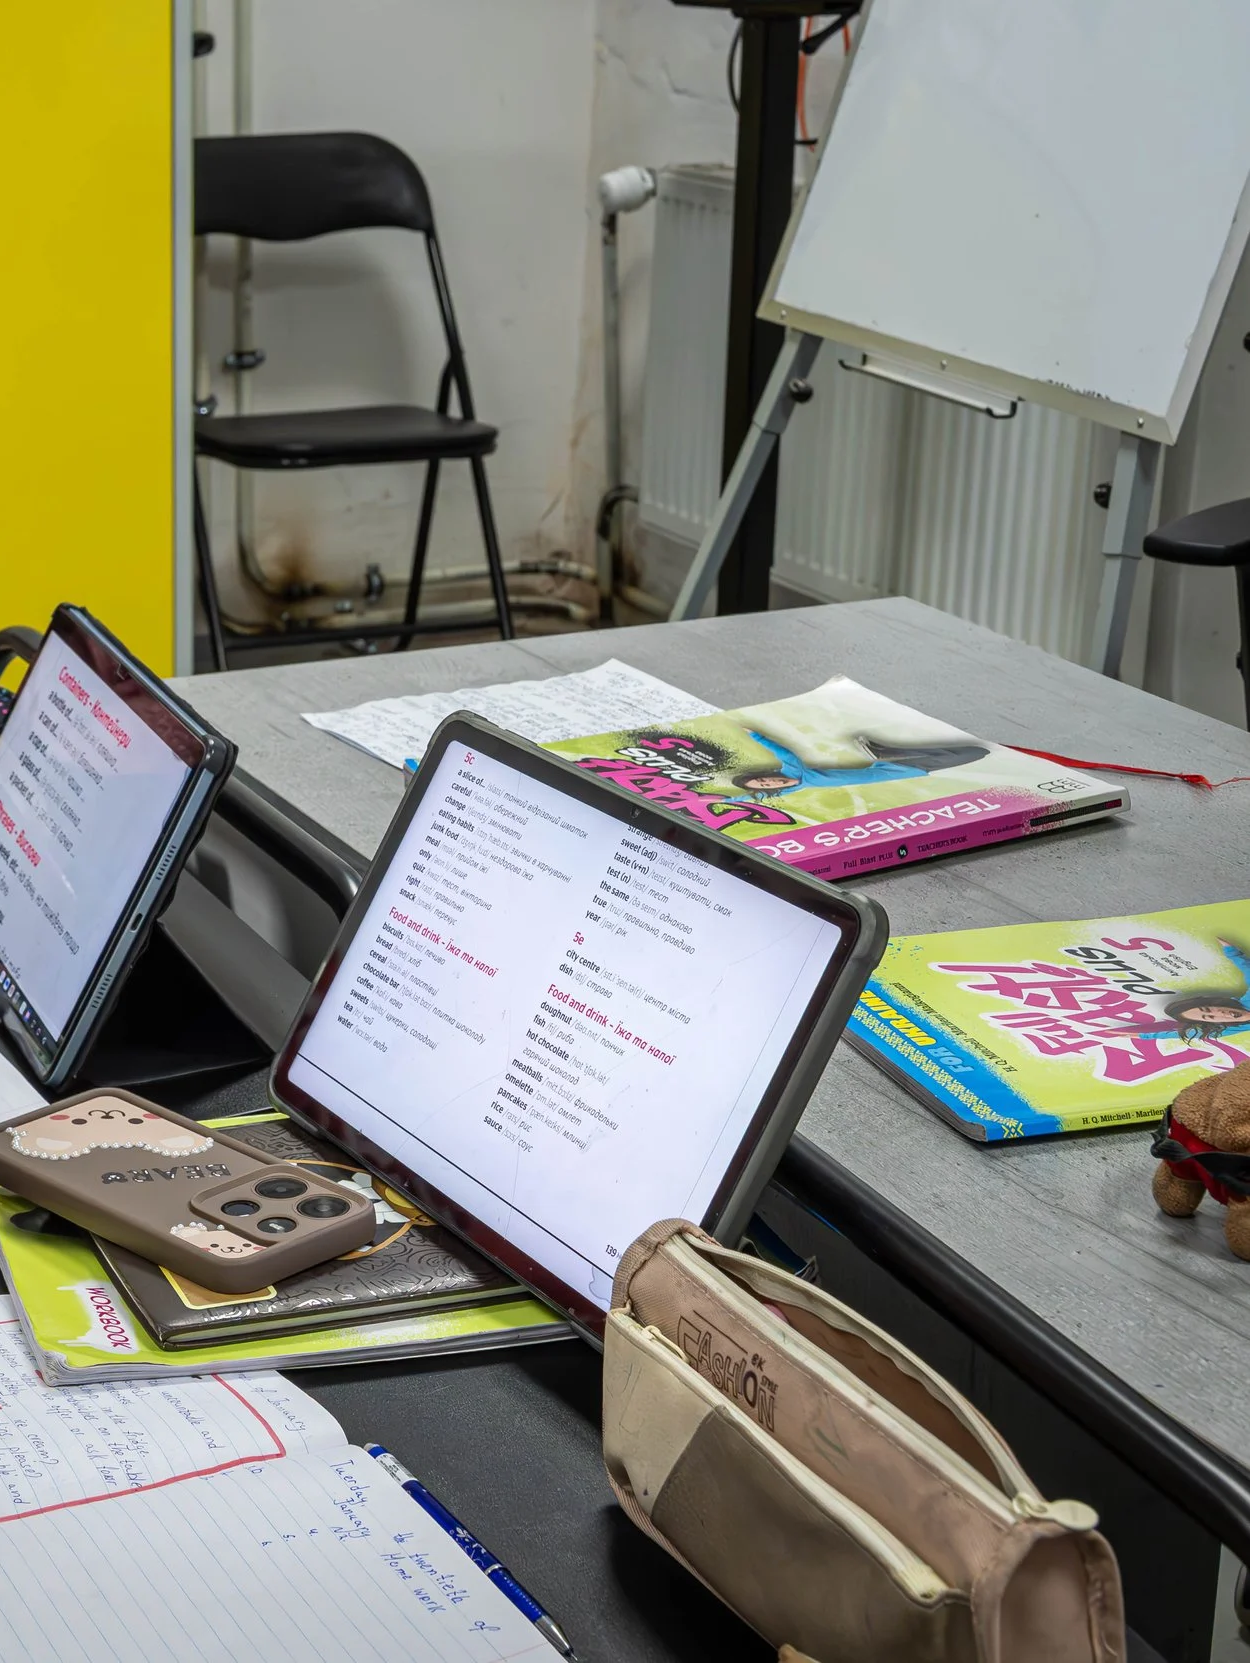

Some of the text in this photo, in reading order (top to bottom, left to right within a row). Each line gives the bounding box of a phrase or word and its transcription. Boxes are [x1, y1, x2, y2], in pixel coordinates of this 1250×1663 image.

[58, 666, 90, 706] Containers
[90, 700, 132, 748] Контейнери
[640, 738, 695, 750] 5
[464, 752, 476, 764] 5c
[617, 747, 712, 782] PLUS
[462, 772, 476, 782] slice
[452, 782, 472, 797] careful
[444, 796, 466, 812] change
[438, 808, 474, 832] eating habits
[812, 798, 1002, 847] TEACHER'S
[430, 820, 459, 840] junk food
[424, 836, 441, 847] meal
[620, 838, 642, 853] sweet
[640, 846, 658, 862] (adj)
[756, 840, 806, 859] BO
[418, 848, 432, 861] only
[412, 862, 426, 874] quiz
[614, 852, 630, 866] taste
[630, 860, 650, 876] (v+n)
[406, 874, 420, 888] right
[606, 866, 620, 878] test
[620, 872, 631, 884] (n)
[398, 888, 416, 902] snack
[600, 880, 612, 892] the
[610, 888, 630, 902] same
[592, 894, 608, 908] true
[584, 910, 601, 922] year
[382, 922, 404, 940] biscuits
[572, 932, 584, 946] 5e
[376, 934, 393, 950] bread
[388, 906, 408, 924] Food
[406, 920, 422, 932] and
[420, 926, 440, 944] drink
[446, 940, 462, 956] Їжа
[460, 952, 474, 964] та
[474, 960, 498, 978] напої
[1100, 937, 1175, 951] 5
[370, 950, 387, 964] cereal
[566, 950, 580, 962] city
[578, 956, 600, 974] centre
[362, 962, 400, 990] chocolate bar
[558, 964, 574, 976] dish
[1064, 946, 1176, 995] PLUS
[356, 976, 374, 990] coffee
[350, 988, 369, 1004] sweets
[344, 1000, 354, 1012] tea
[540, 1002, 572, 1024] doughnut
[338, 1014, 353, 1030] water
[534, 1014, 546, 1028] fish
[548, 984, 570, 1004] Food
[568, 998, 586, 1014] and
[586, 1008, 608, 1027] drink
[614, 1020, 632, 1040] Їжа
[632, 1036, 647, 1050] та
[646, 1046, 676, 1066] напої
[859, 989, 975, 1073] FOR UKRAINE
[988, 1011, 1104, 1056] Full
[526, 1028, 570, 1060] hot chocolate
[512, 1058, 544, 1082] meatballs
[504, 1072, 534, 1096] omelette
[496, 1086, 528, 1110] pancakes
[490, 1102, 504, 1114] rice
[484, 1116, 502, 1132] sauce
[1082, 1117, 1091, 1125] H.
[1100, 1111, 1131, 1123] Mitchell
[127, 1163, 232, 1183] BEAR
[606, 1244, 617, 1258] 139
[85, 1287, 132, 1349] WORKBOOK
[677, 1315, 775, 1433] FASHION
